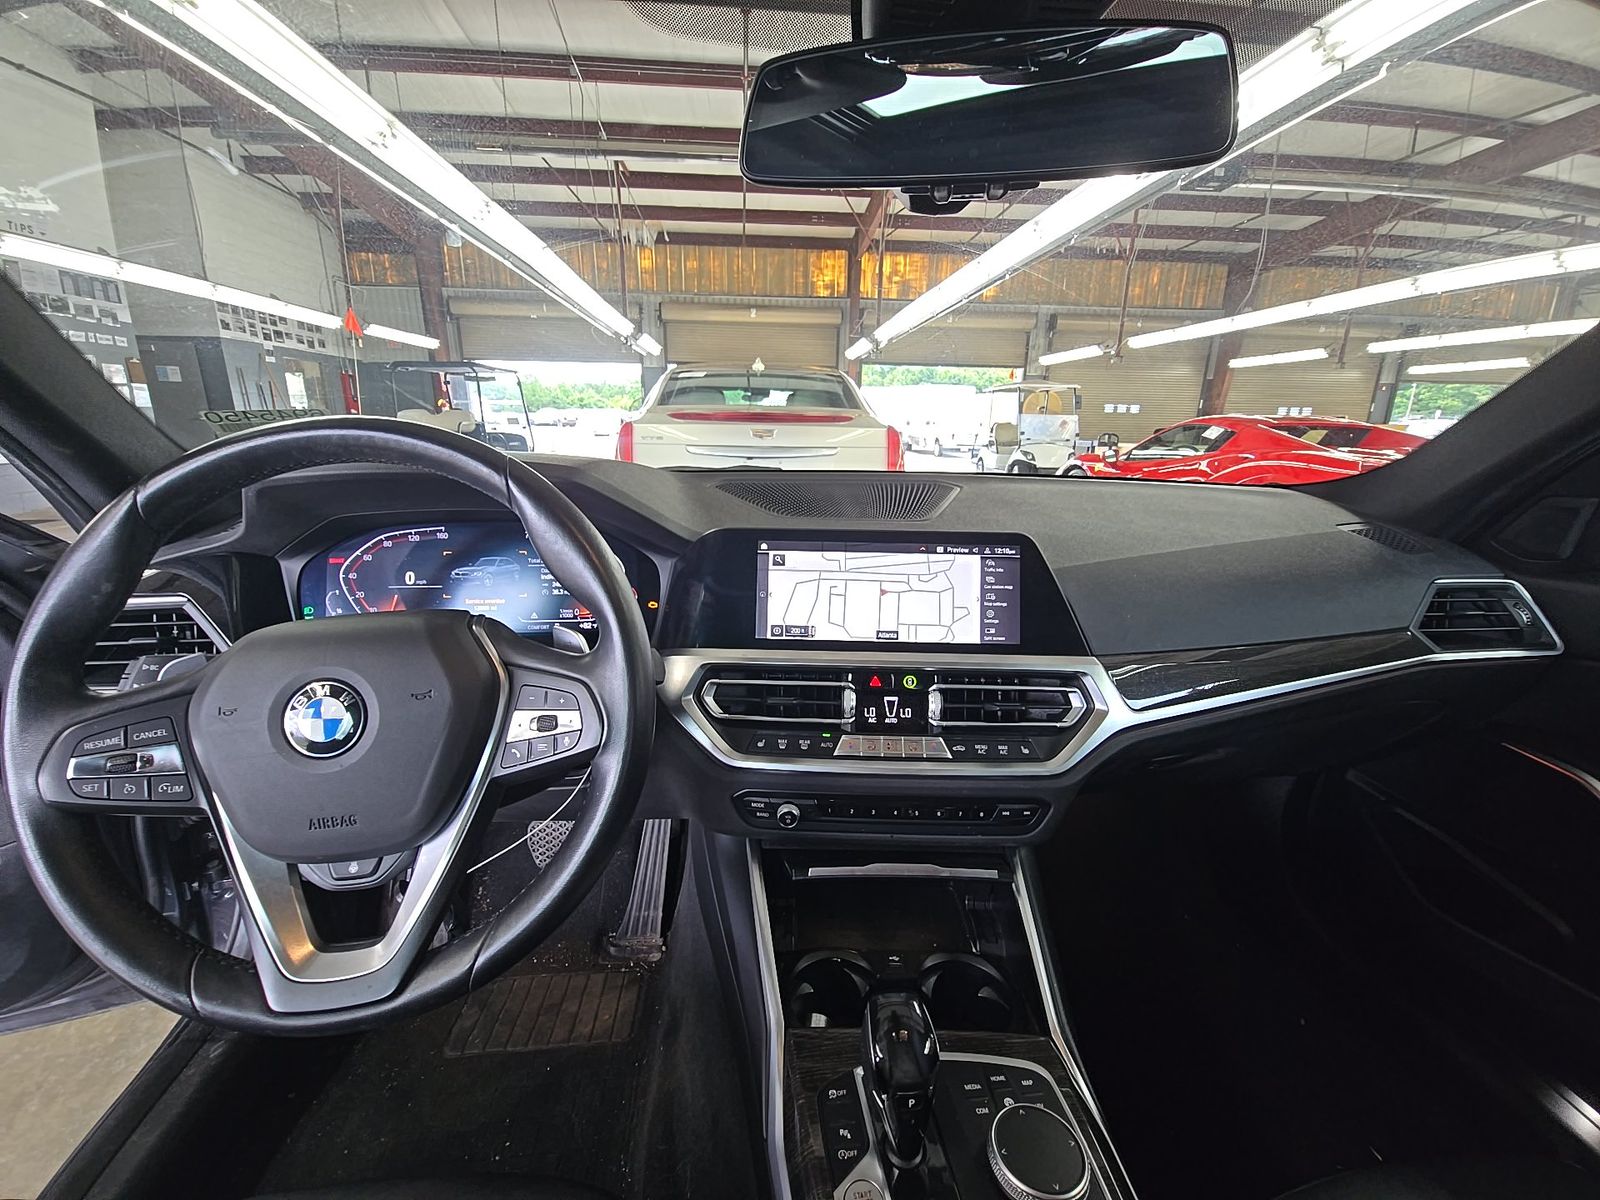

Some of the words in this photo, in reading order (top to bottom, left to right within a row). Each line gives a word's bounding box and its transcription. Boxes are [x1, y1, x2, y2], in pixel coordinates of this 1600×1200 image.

[6, 220, 34, 235] TIPS
[946, 546, 969, 554] Preview
[404, 571, 415, 585] 0
[293, 684, 356, 711] BMW
[864, 707, 876, 717] LO
[900, 708, 912, 718] LO
[133, 728, 168, 741] CANCEL
[84, 736, 121, 750] RESUME
[82, 784, 99, 792] SET
[168, 784, 184, 793] LIM
[308, 814, 358, 831] AIRBAG
[908, 1099, 916, 1108] P
[853, 1190, 872, 1200] START
